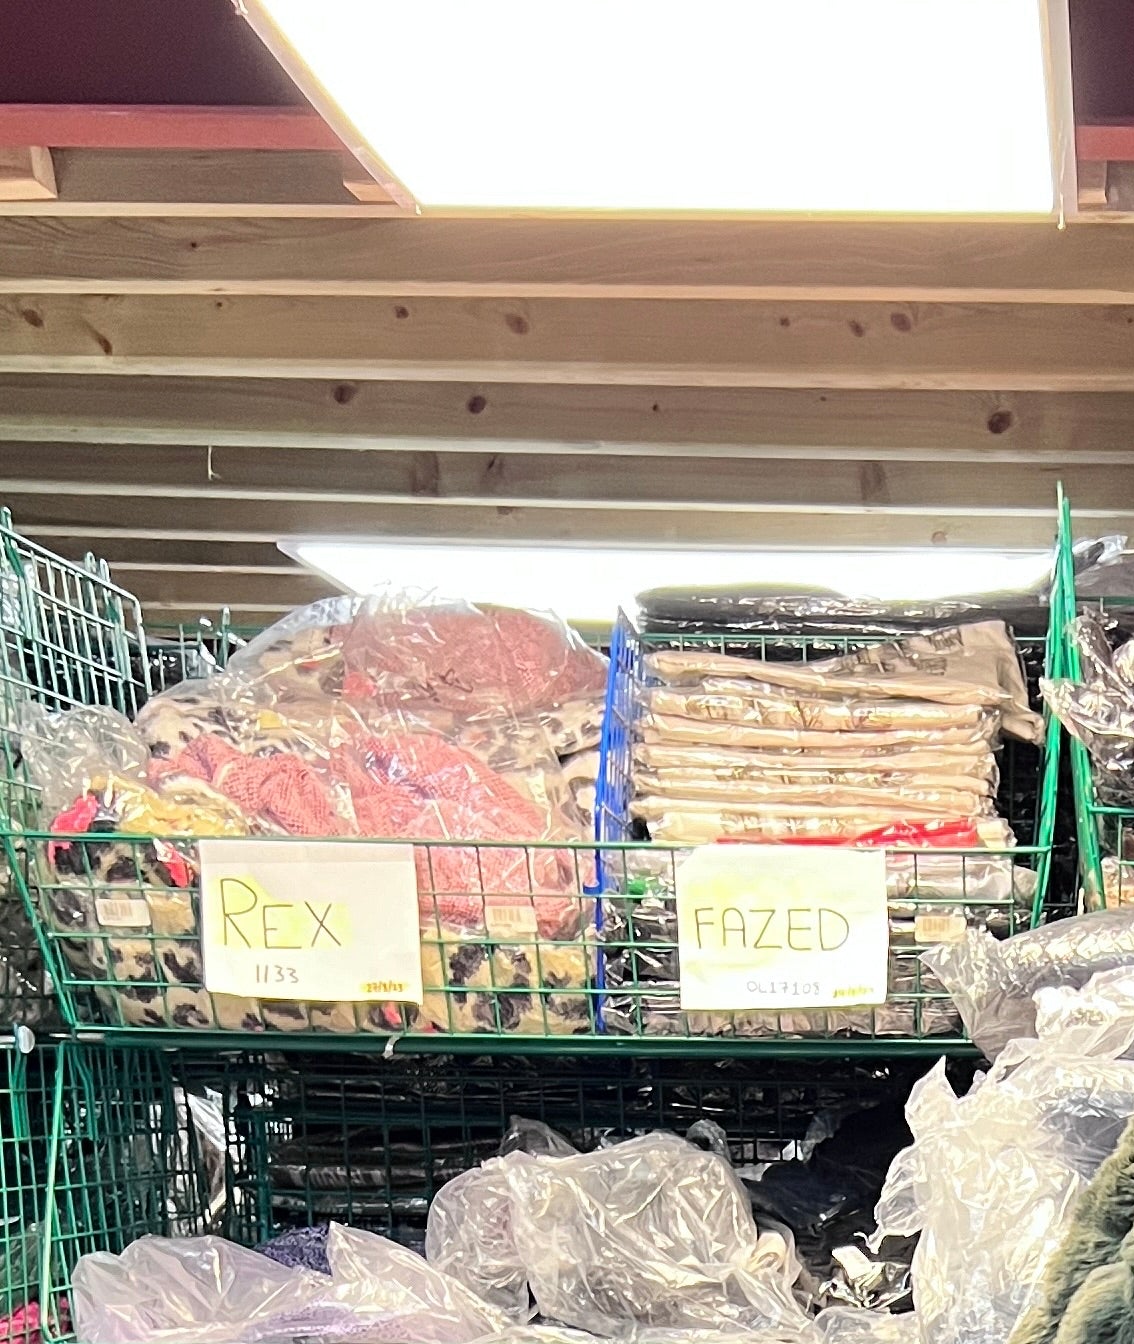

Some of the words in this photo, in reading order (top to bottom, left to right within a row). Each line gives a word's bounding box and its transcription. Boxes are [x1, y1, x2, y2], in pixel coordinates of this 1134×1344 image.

[220, 878, 341, 948] REX
[694, 907, 850, 951] FAZED
[256, 964, 299, 984] 1133
